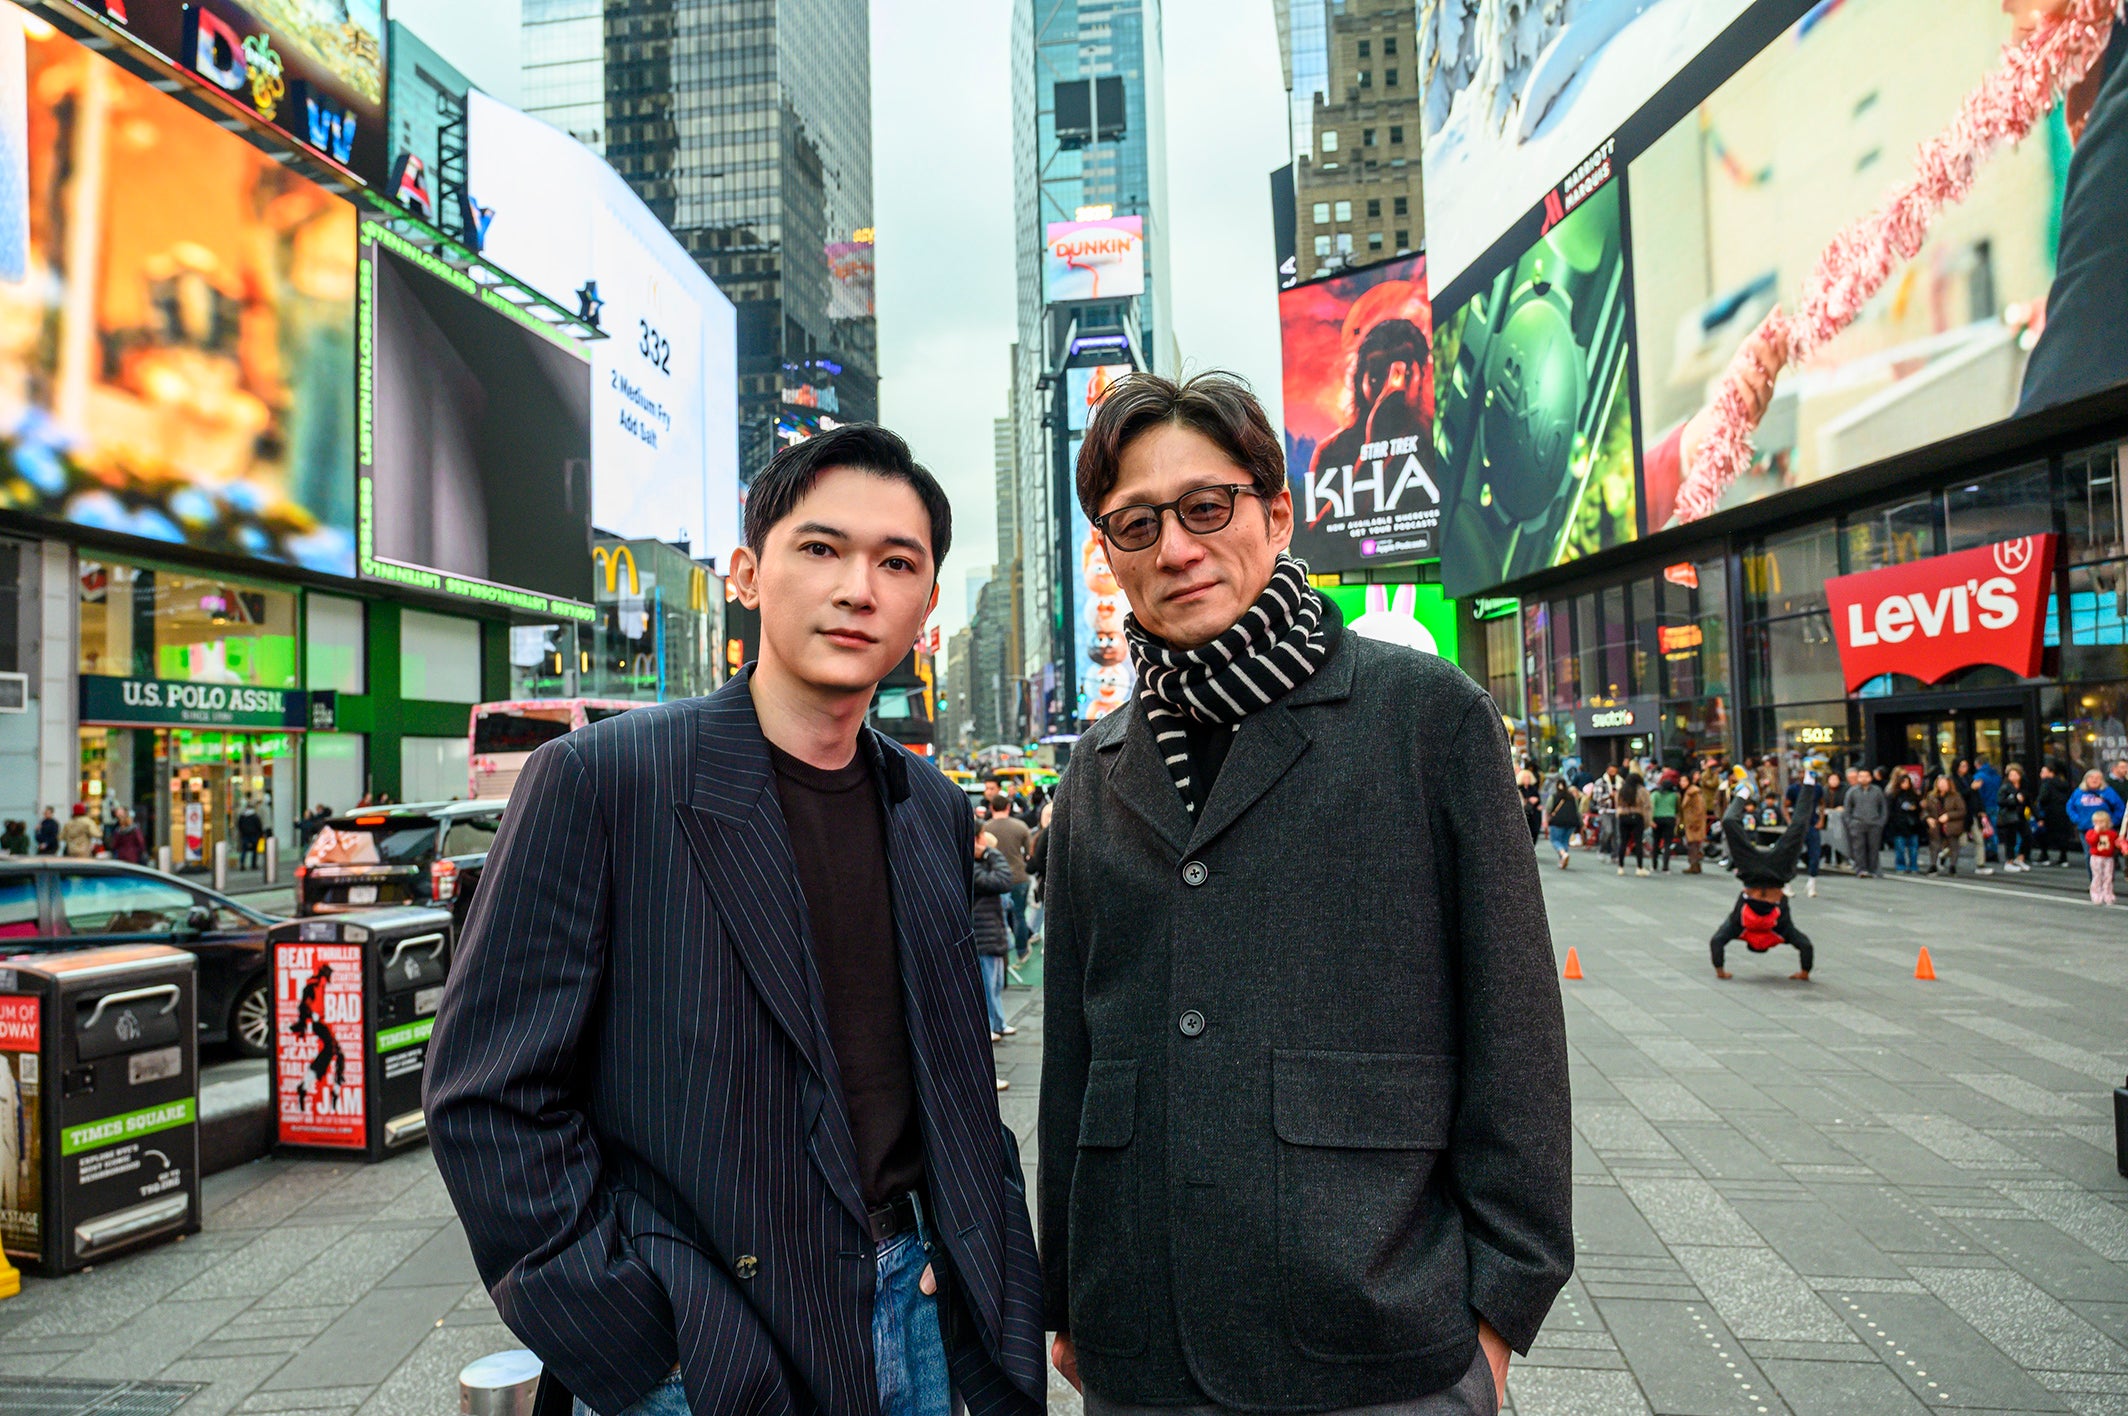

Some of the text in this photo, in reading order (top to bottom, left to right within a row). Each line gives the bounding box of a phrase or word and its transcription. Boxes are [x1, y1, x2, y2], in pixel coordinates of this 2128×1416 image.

[1563, 137, 1615, 194] MARRIOTT
[1564, 162, 1610, 211] MARQUIS
[639, 319, 670, 376] 332
[611, 369, 618, 389] 2
[619, 408, 637, 436] Add
[1361, 435, 1418, 461] STAR TREK
[1326, 523, 1345, 533] NOW
[122, 681, 286, 713] U.S. POLO ASSN.
[278, 947, 315, 968] BEAT
[317, 947, 361, 961] THRILLER
[278, 969, 314, 1000] IT
[19, 1004, 36, 1021] OF
[324, 994, 361, 1023] BAD
[70, 1104, 186, 1146] TIMES SQUARE
